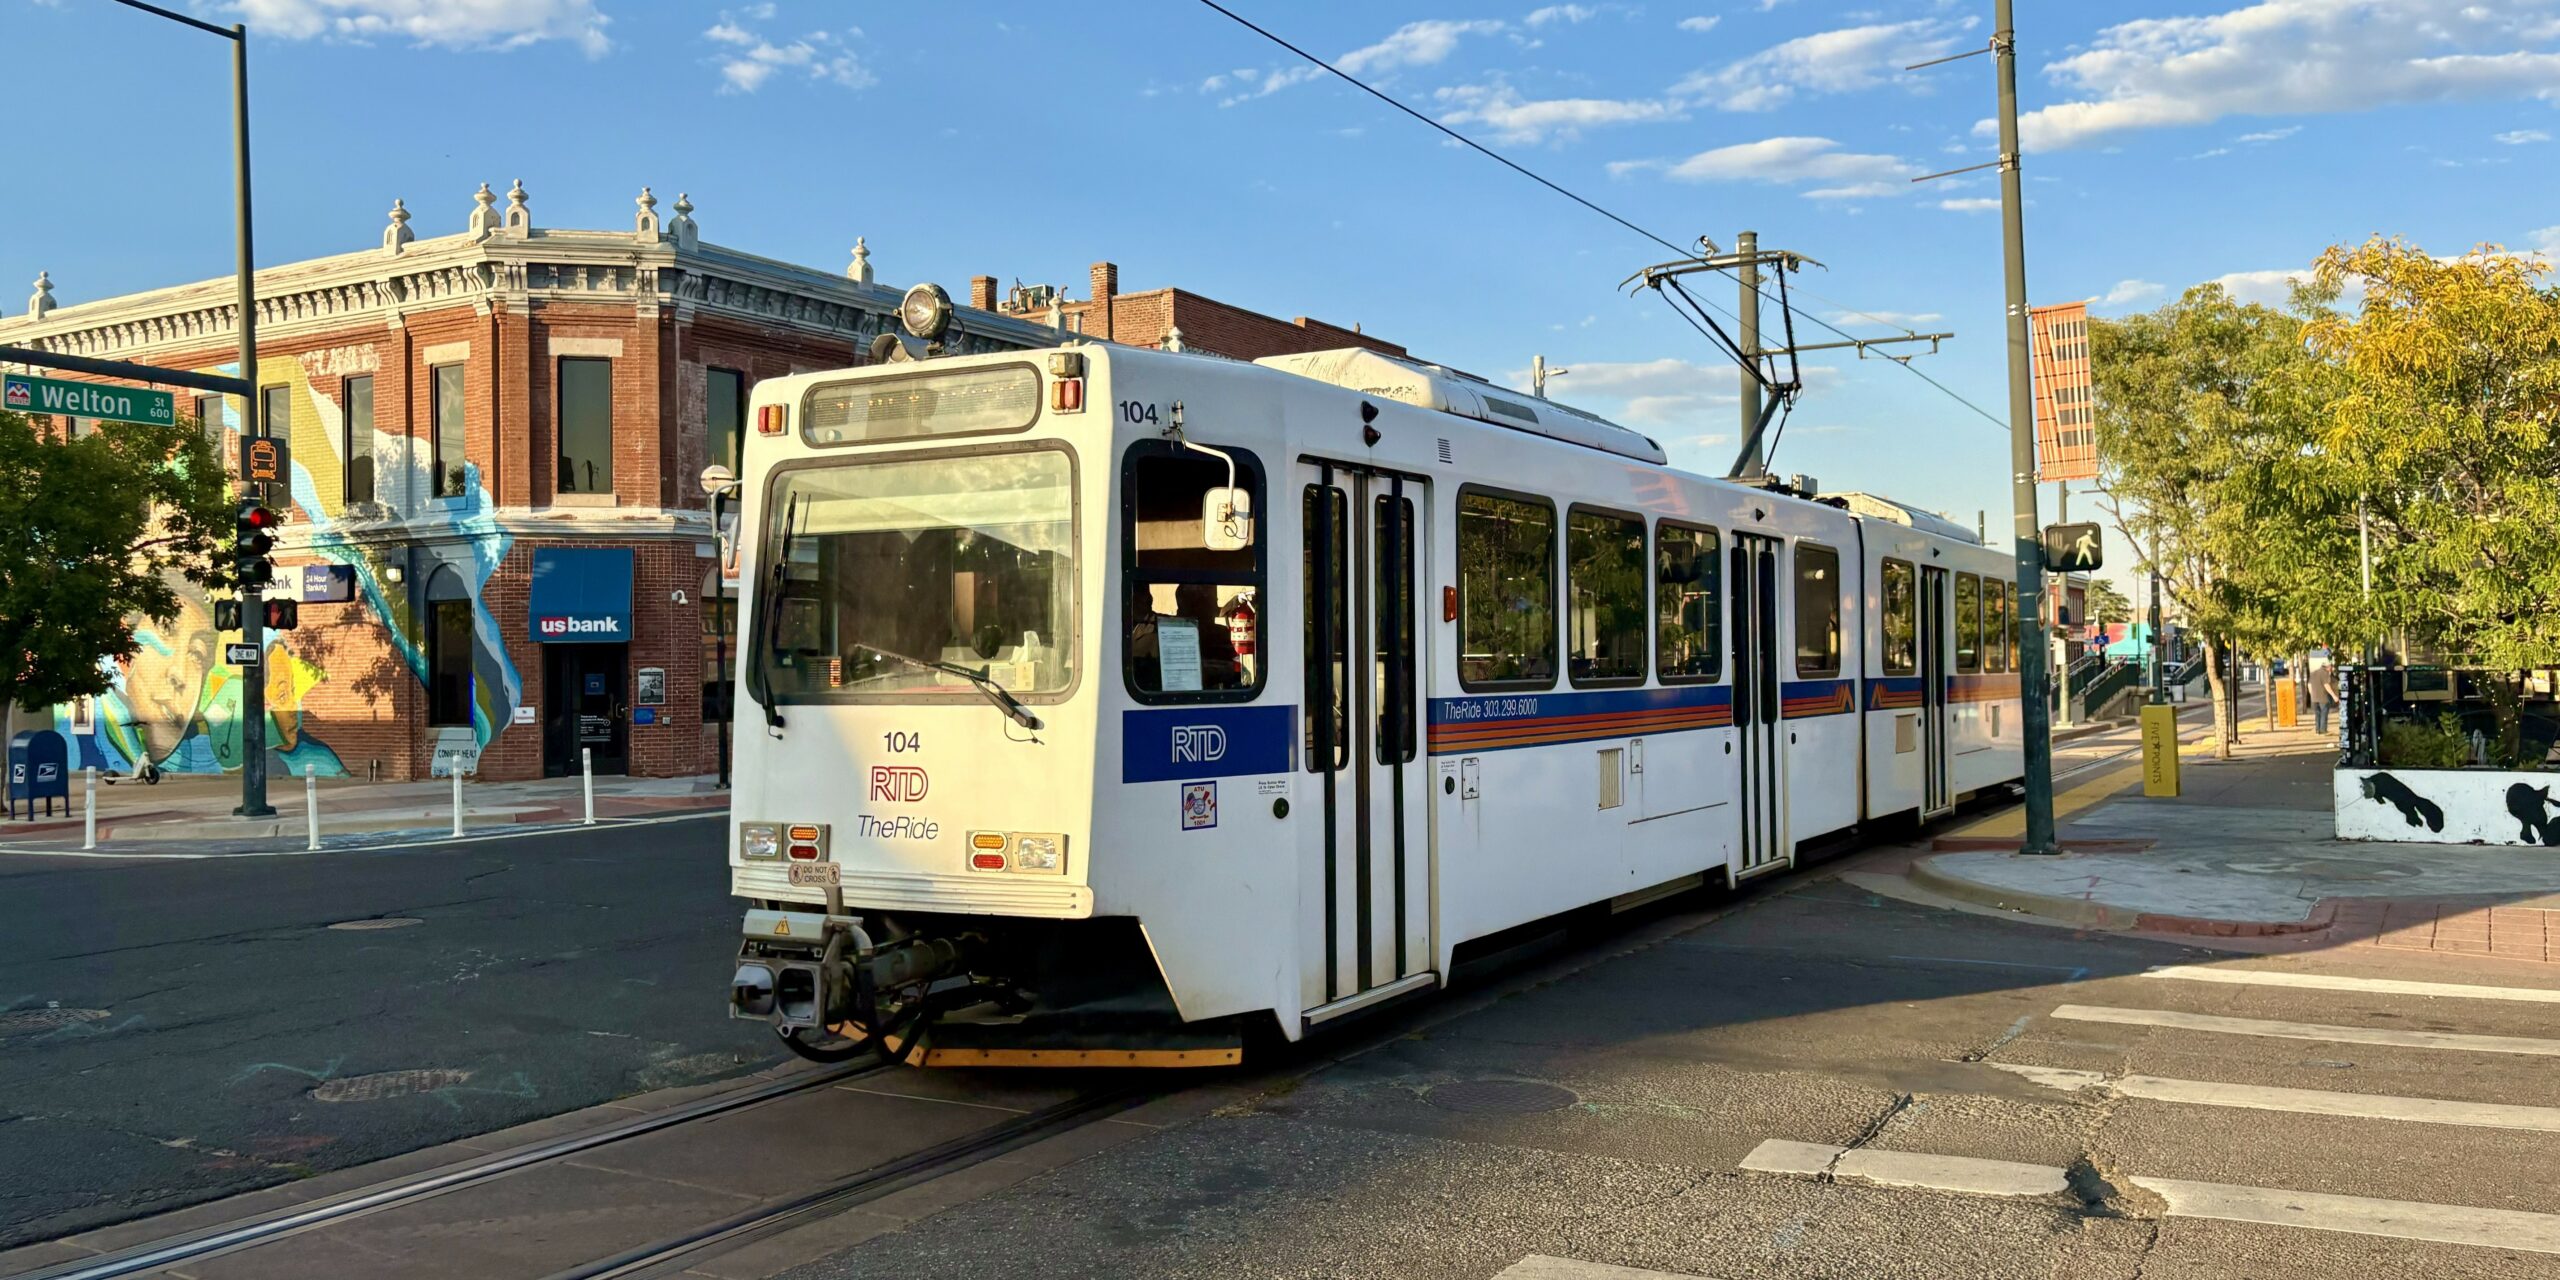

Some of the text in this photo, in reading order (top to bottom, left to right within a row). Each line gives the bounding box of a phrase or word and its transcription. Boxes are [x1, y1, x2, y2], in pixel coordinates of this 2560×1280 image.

[41, 385, 132, 416] Welton
[155, 397, 165, 408] St
[150, 408, 170, 419] 600
[1119, 400, 1160, 425] 104
[305, 584, 327, 593] Banking
[314, 574, 327, 583] Hour
[541, 616, 619, 633] usbank
[246, 650, 256, 659] WAY
[1444, 698, 1538, 720] TheRide 303.299.6000
[883, 731, 921, 753] 104
[1171, 724, 1227, 764] RTD
[2151, 721, 2162, 785] FIVE POINTS
[870, 766, 929, 802] RTD
[858, 814, 939, 840] TheRide
[803, 866, 828, 874] DO NOT
